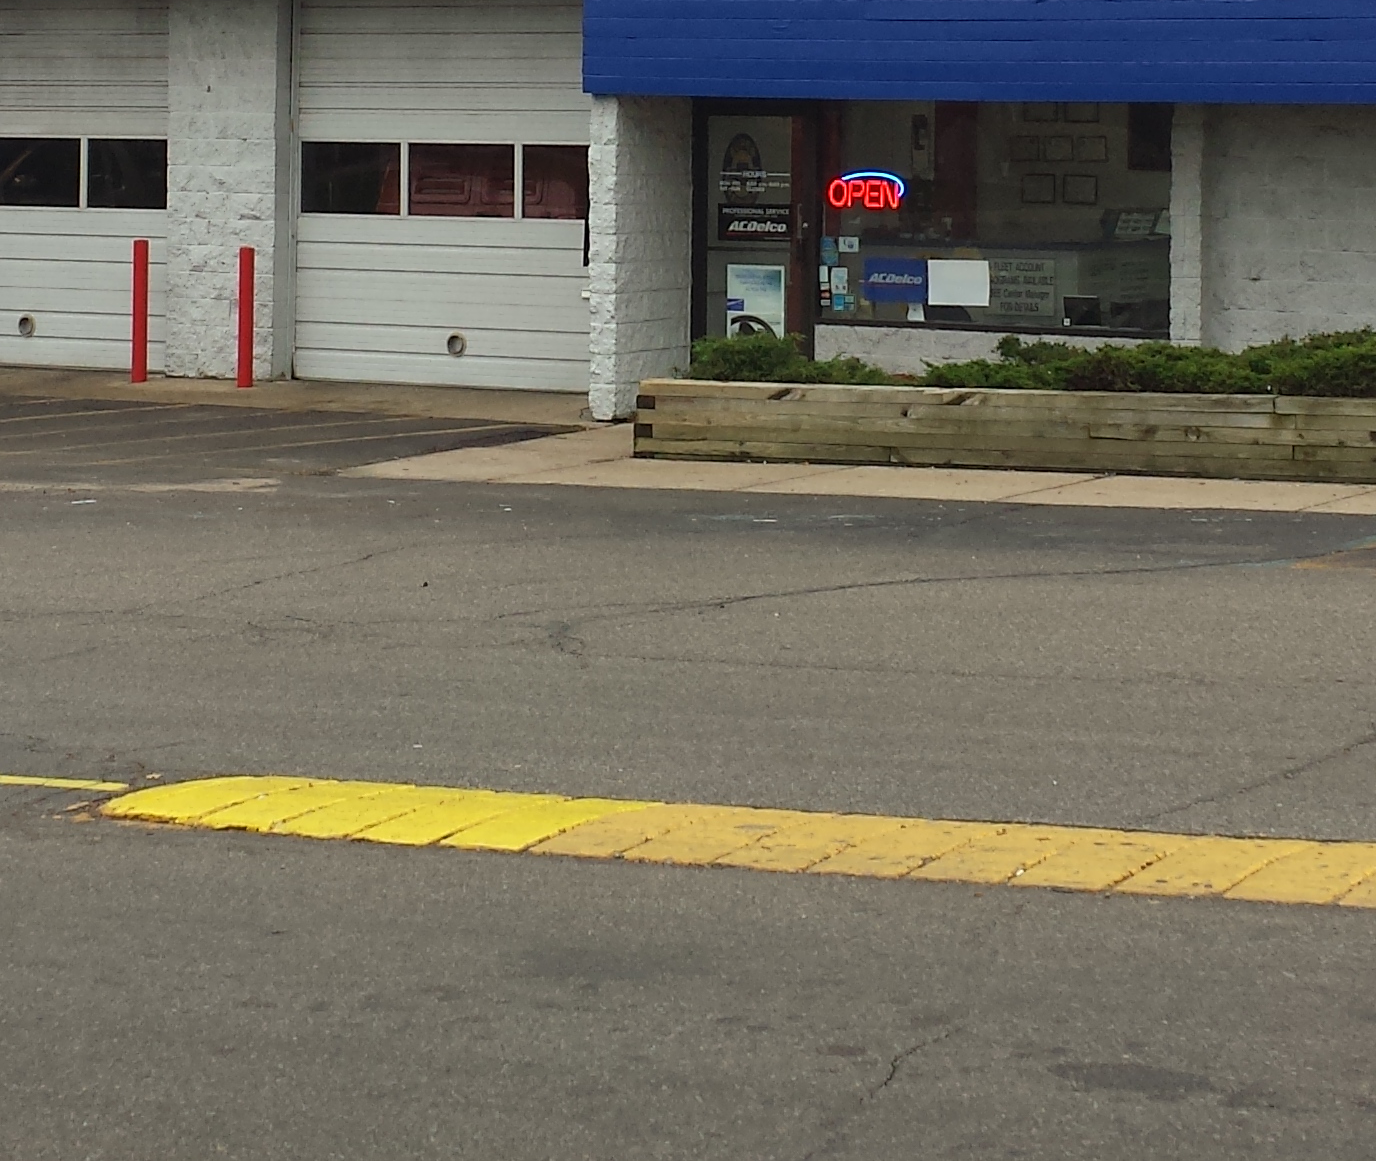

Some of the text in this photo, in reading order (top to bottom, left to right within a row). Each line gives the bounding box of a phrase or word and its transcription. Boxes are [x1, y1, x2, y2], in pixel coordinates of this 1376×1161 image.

[827, 177, 901, 210] OPEN
[727, 220, 787, 233] ACDelco
[868, 272, 923, 285] ACDelco
